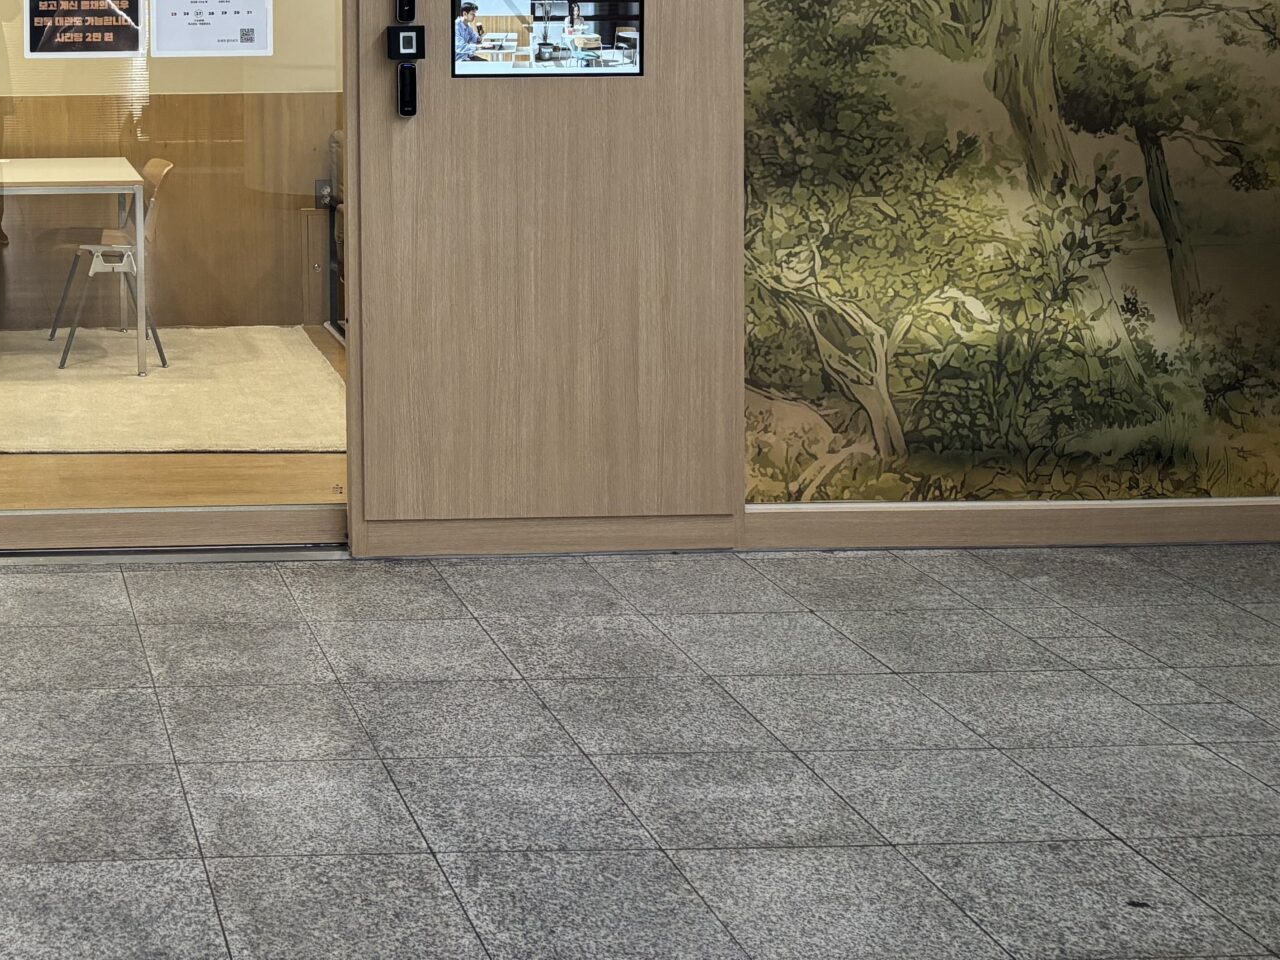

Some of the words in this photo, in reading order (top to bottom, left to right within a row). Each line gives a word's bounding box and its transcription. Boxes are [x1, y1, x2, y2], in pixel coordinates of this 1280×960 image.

[39, 1, 57, 10] 보고
[60, 0, 78, 10] 계신
[55, 32, 82, 42] 시간당
[86, 33, 102, 42] 2만
